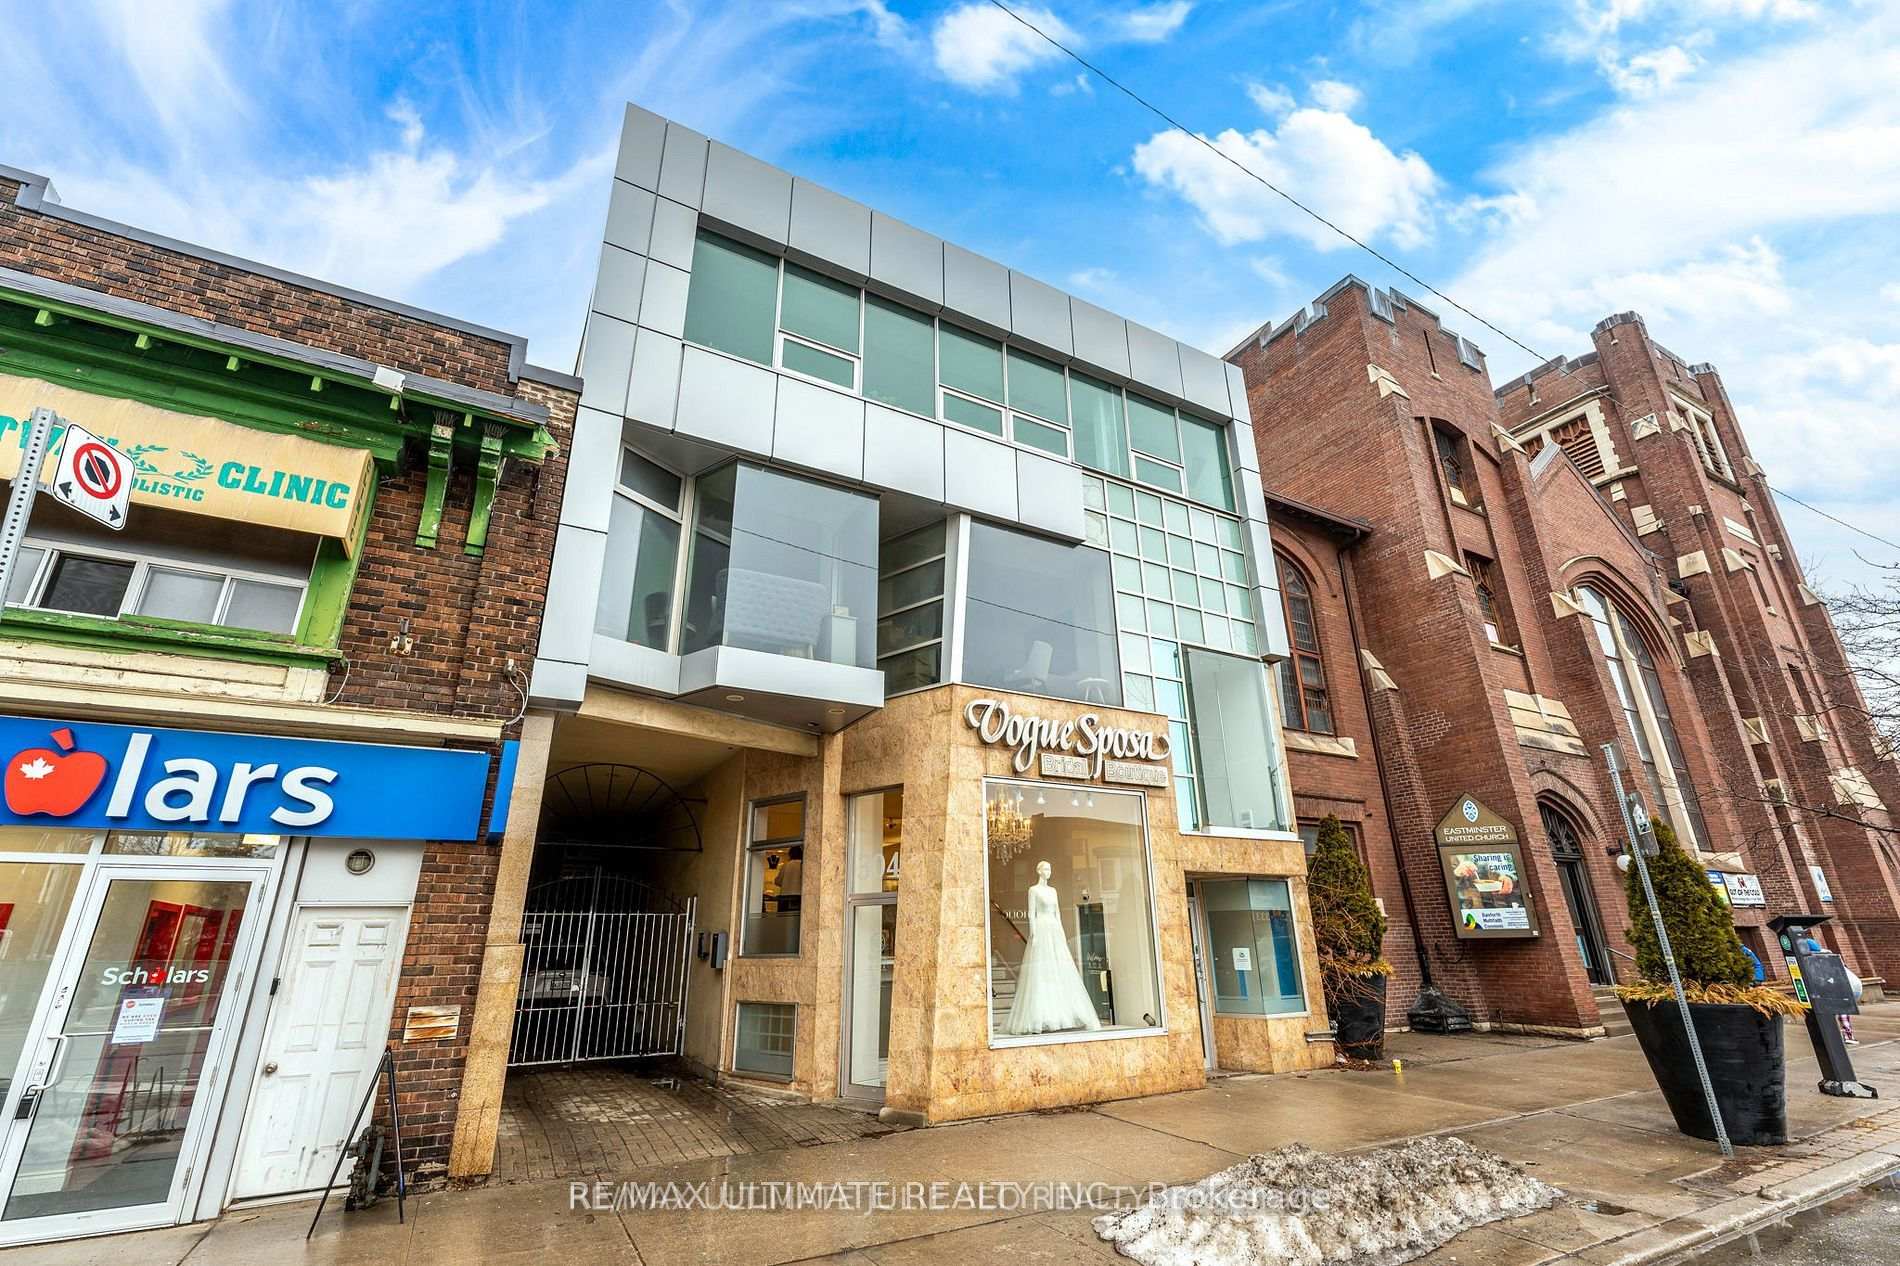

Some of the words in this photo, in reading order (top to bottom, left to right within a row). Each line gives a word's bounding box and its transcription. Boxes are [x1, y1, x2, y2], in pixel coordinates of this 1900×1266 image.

[217, 461, 351, 509] CLINIC
[963, 698, 1075, 772] Vogue
[1075, 713, 1171, 779] Sposa
[1043, 755, 1088, 777] Bridal
[1106, 761, 1167, 784] Boutique
[1443, 825, 1507, 835] EASTMINSTER
[1475, 833, 1509, 841] CHURCH
[1472, 854, 1502, 863] Sharing
[1489, 863, 1513, 872] caring
